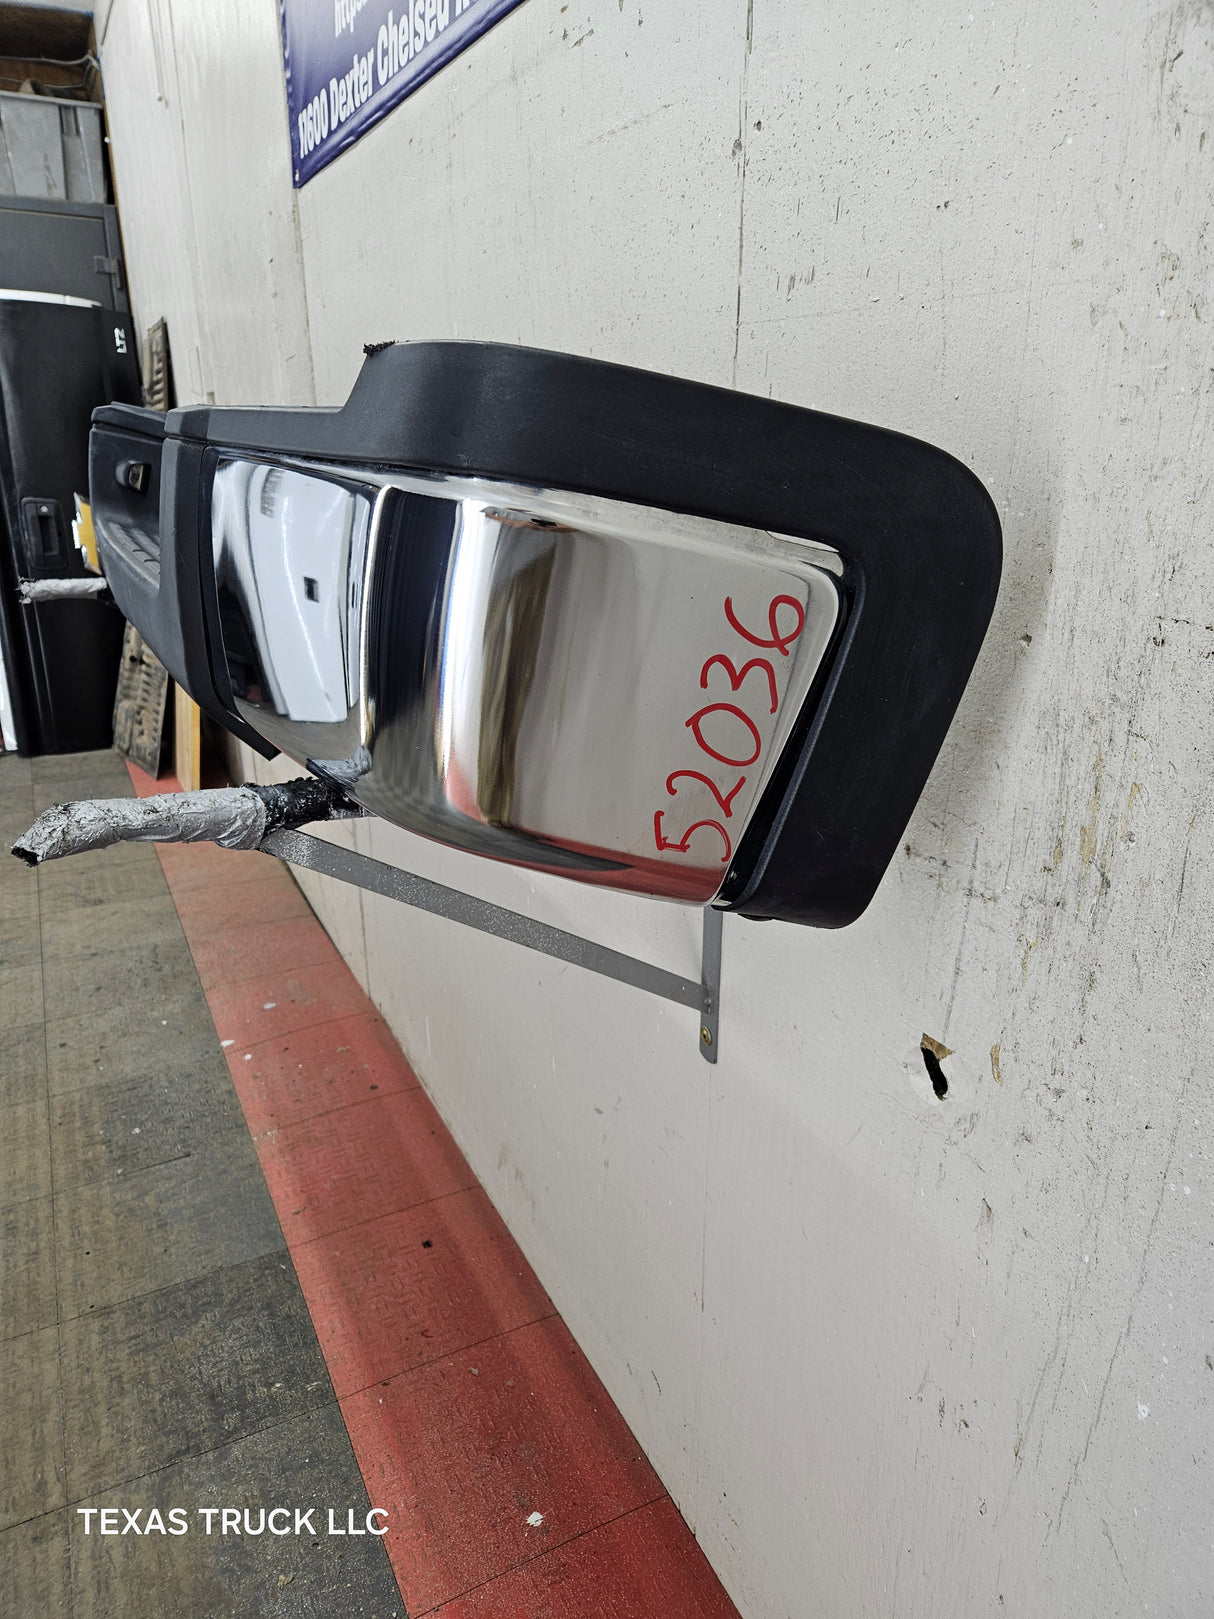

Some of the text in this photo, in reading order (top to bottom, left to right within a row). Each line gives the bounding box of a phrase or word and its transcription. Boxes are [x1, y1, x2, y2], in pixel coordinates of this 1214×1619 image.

[298, 88, 328, 159] 11600
[329, 47, 374, 131] Dexter
[114, 327, 128, 354] LTZ
[653, 594, 805, 863] 52036
